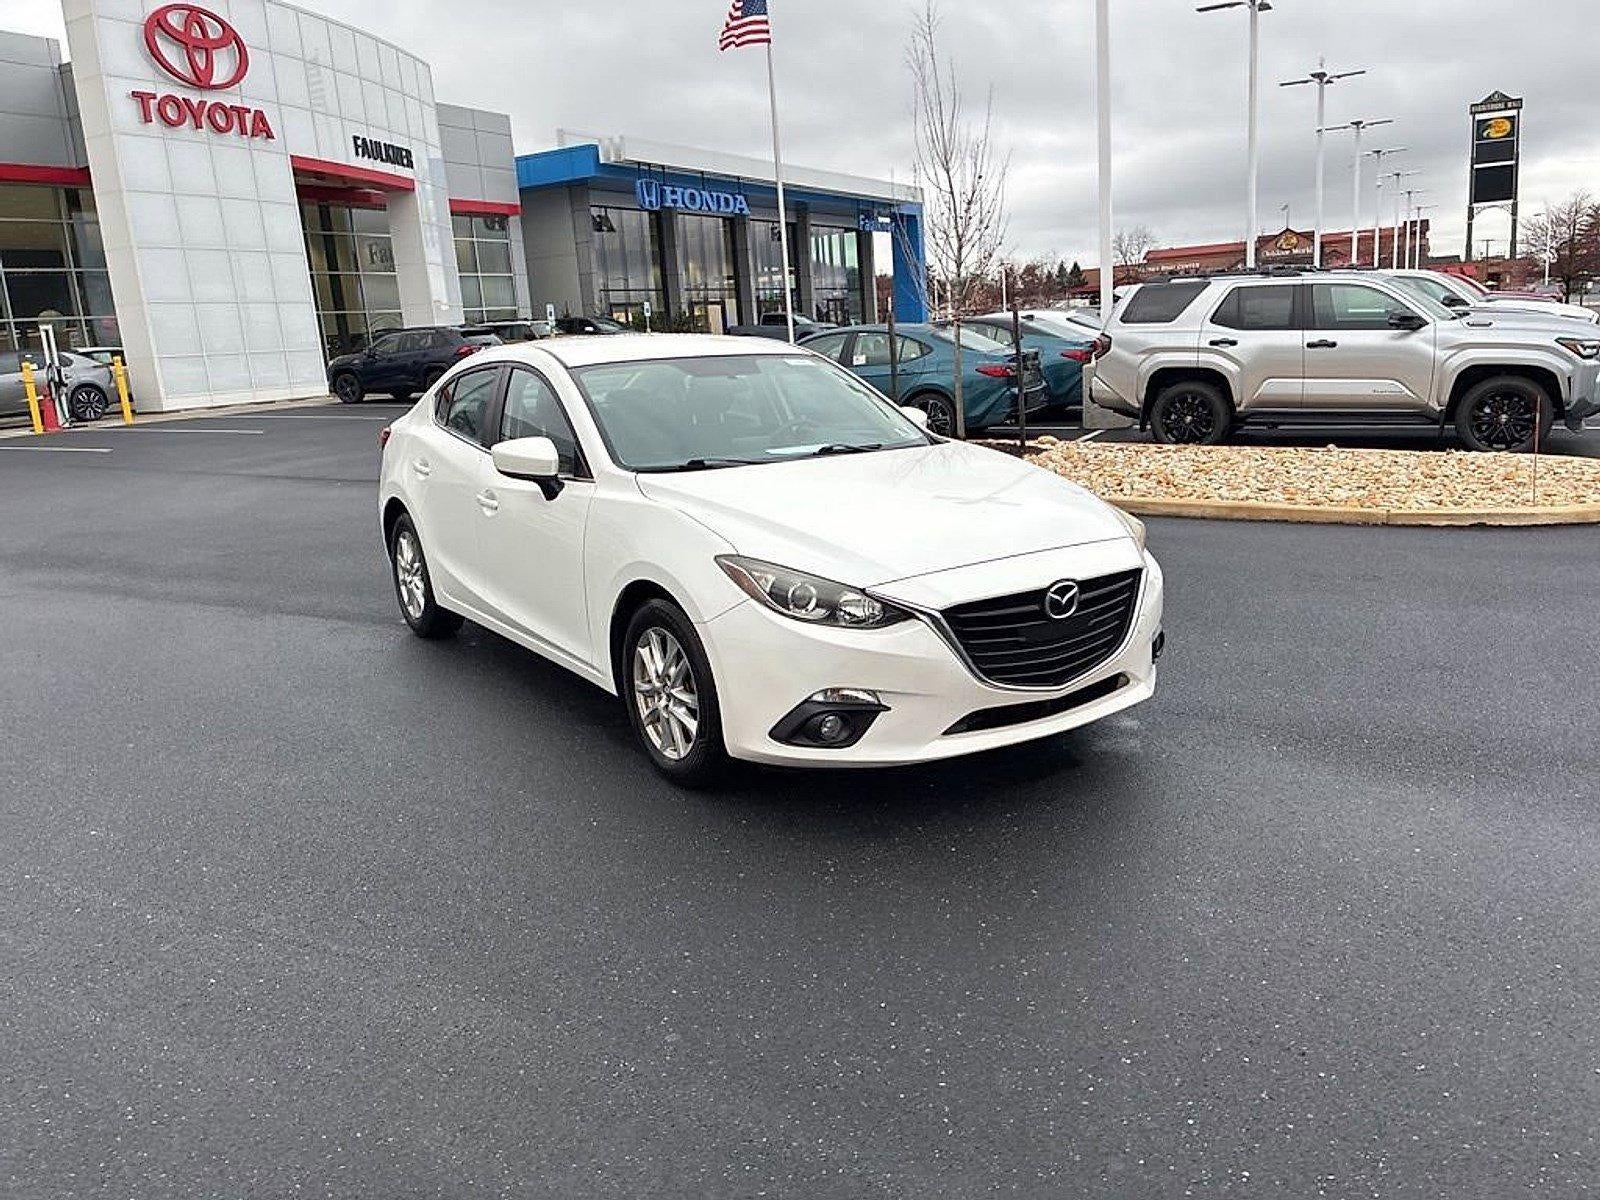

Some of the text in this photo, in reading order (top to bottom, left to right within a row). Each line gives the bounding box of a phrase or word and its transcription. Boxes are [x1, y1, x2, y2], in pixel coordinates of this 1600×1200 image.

[131, 90, 275, 140] TOYOTA
[352, 134, 414, 170] FAULKNER
[663, 185, 750, 214] HONDA
